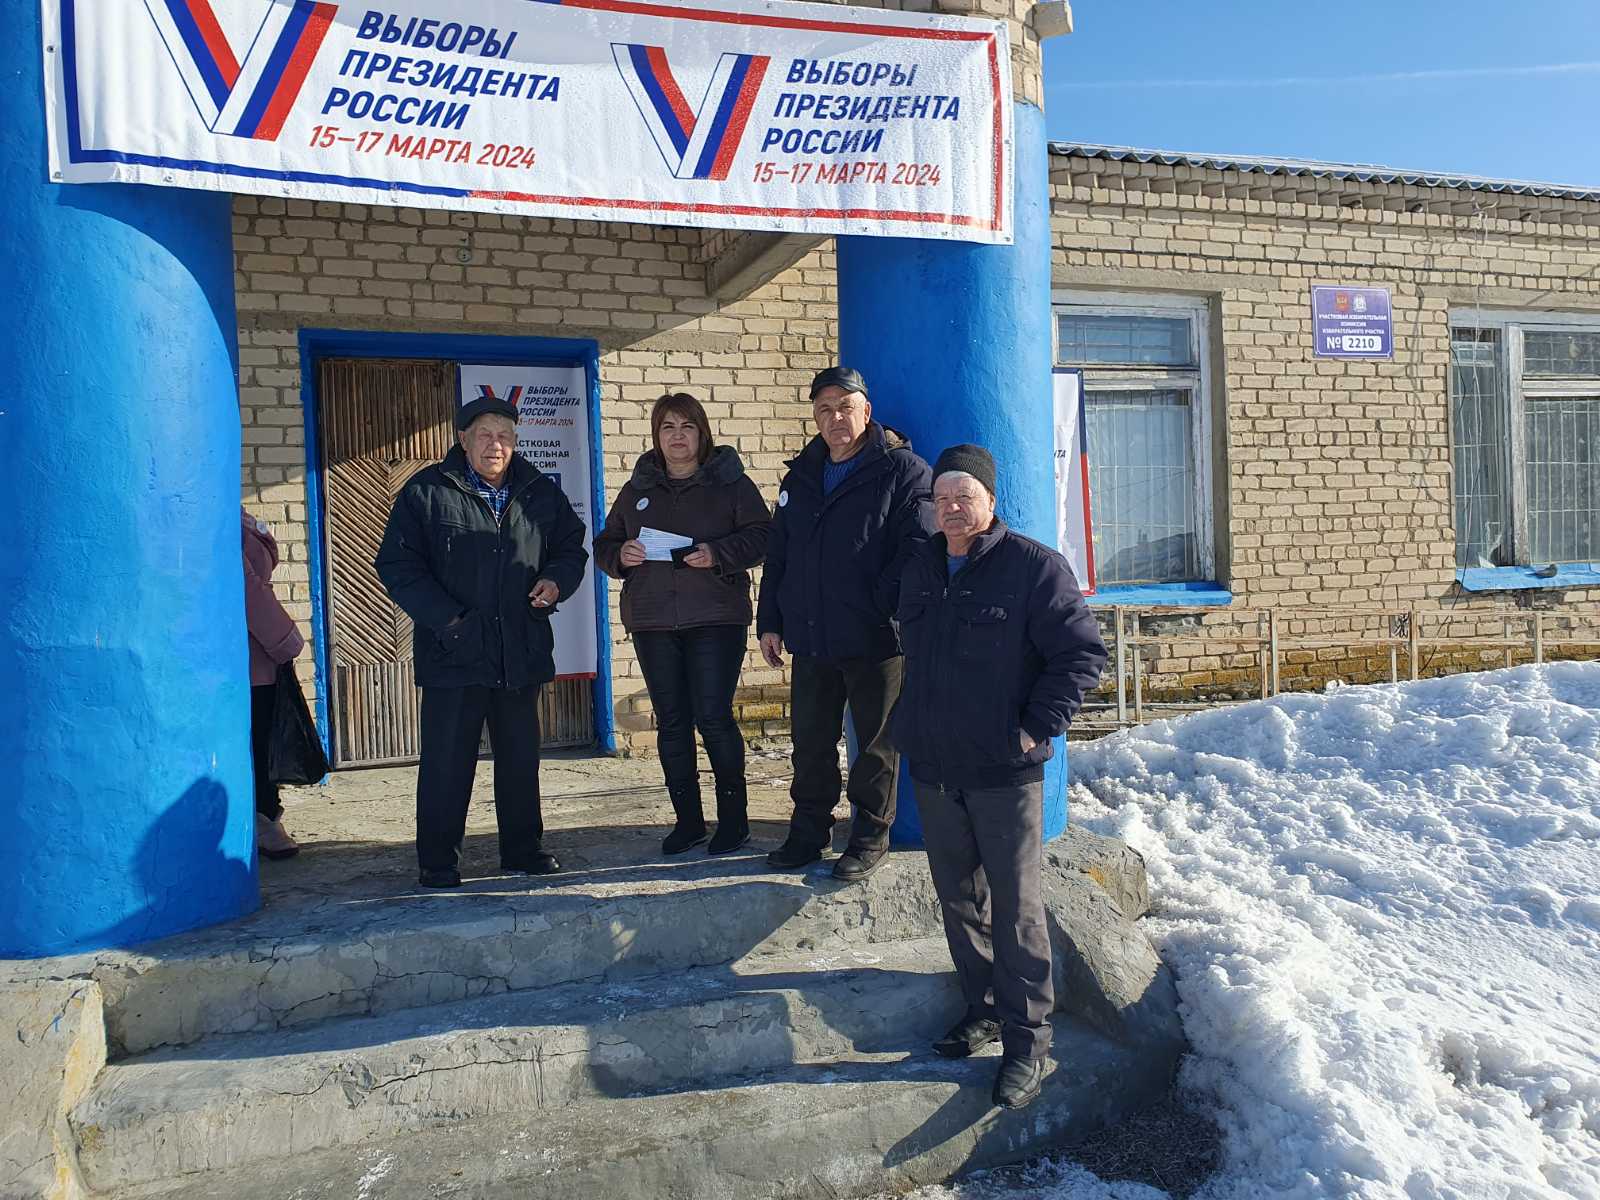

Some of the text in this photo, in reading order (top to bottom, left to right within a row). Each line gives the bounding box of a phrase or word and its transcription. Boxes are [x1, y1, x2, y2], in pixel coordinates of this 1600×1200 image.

[356, 10, 518, 60] ВЫБОРЫ
[339, 48, 561, 102] ПРЕЗИДЕНТА
[786, 58, 919, 87] ВЫБОРЫ
[321, 87, 471, 130] РОССИИ
[773, 93, 961, 124] ПРЕЗИДЕНТА
[760, 127, 885, 155] РОССИИ
[385, 133, 472, 164] МАРТА
[475, 143, 536, 169] 2024
[815, 161, 886, 185] МАРТА
[891, 162, 941, 187] 2024
[1348, 337, 1375, 349] 2210
[527, 386, 568, 395] ВЫБОРЫ
[523, 396, 581, 407] ПРЕЗИДЕНТА
[519, 407, 556, 417] РОССИИ
[537, 418, 557, 427] МАРТА
[515, 439, 561, 448] СТКОВАЯ
[516, 450, 570, 459] РАТЕЛЬНАЯ
[530, 460, 557, 469] ССИЯ
